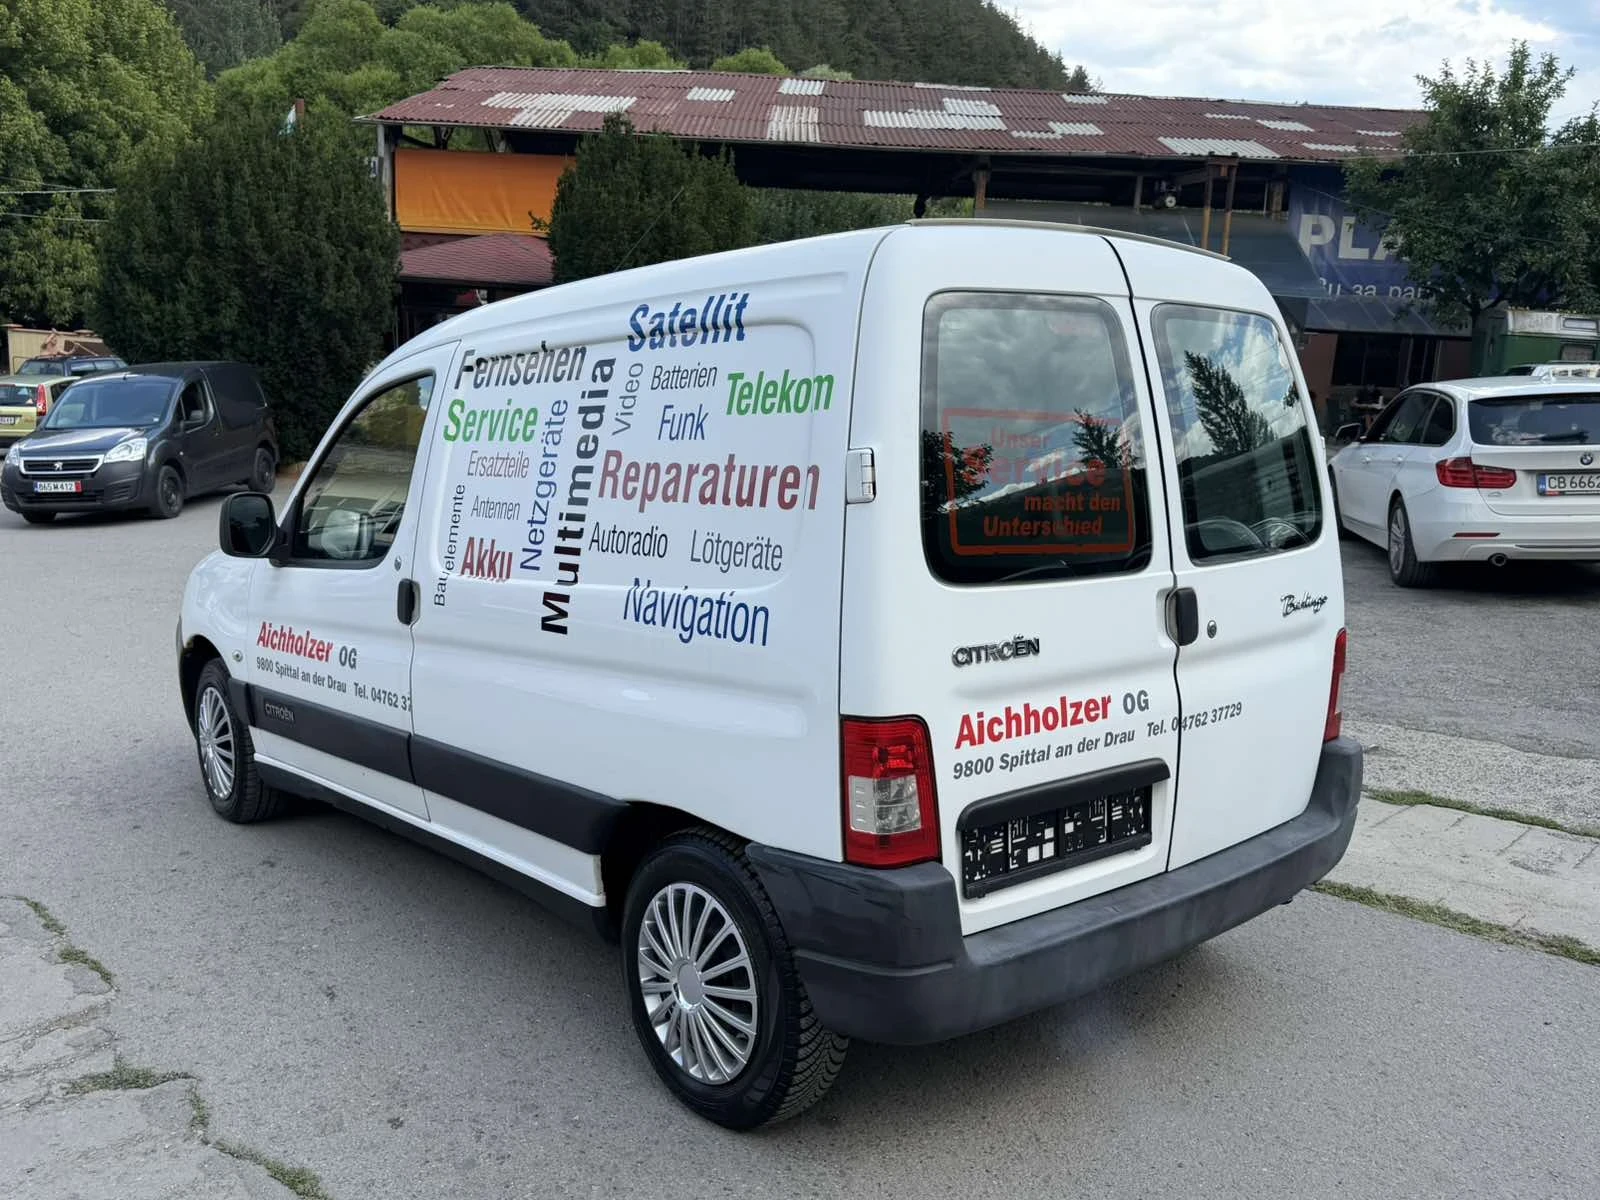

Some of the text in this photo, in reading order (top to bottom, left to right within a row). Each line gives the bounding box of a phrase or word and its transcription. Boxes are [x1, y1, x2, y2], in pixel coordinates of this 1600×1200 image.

[627, 292, 750, 352] Satellit
[454, 340, 587, 390] Fernsehen
[650, 361, 718, 391] Batterien
[611, 362, 644, 436] Video
[725, 369, 834, 416] Telekom
[443, 398, 539, 443] Service
[657, 403, 709, 441] Funk
[467, 450, 530, 479] Ersatzteile
[519, 399, 569, 571] Netzgeräte
[598, 449, 820, 513] Reparaturen
[471, 495, 521, 521] Antennen
[541, 357, 617, 635] Multimedia
[1024, 491, 1121, 512] macht den
[433, 483, 466, 607] Bauelemente
[588, 521, 669, 559] Autoradio
[983, 515, 1105, 537] Unterschied
[460, 536, 513, 581] Akku
[690, 529, 784, 574] Lötgeräte
[623, 577, 770, 647] Navigation
[256, 620, 358, 670] Aichholzer OG
[256, 656, 274, 674] 9800
[275, 663, 301, 681] Spittal
[301, 670, 311, 683] an
[312, 670, 326, 688] der
[327, 674, 348, 694] Drau
[353, 681, 369, 700] Tel.
[370, 686, 399, 710] 04762
[952, 701, 1243, 780] 9800 Spittal an der Drau Tel. 04762 37729
[954, 689, 1150, 751] Aichholzer OG
